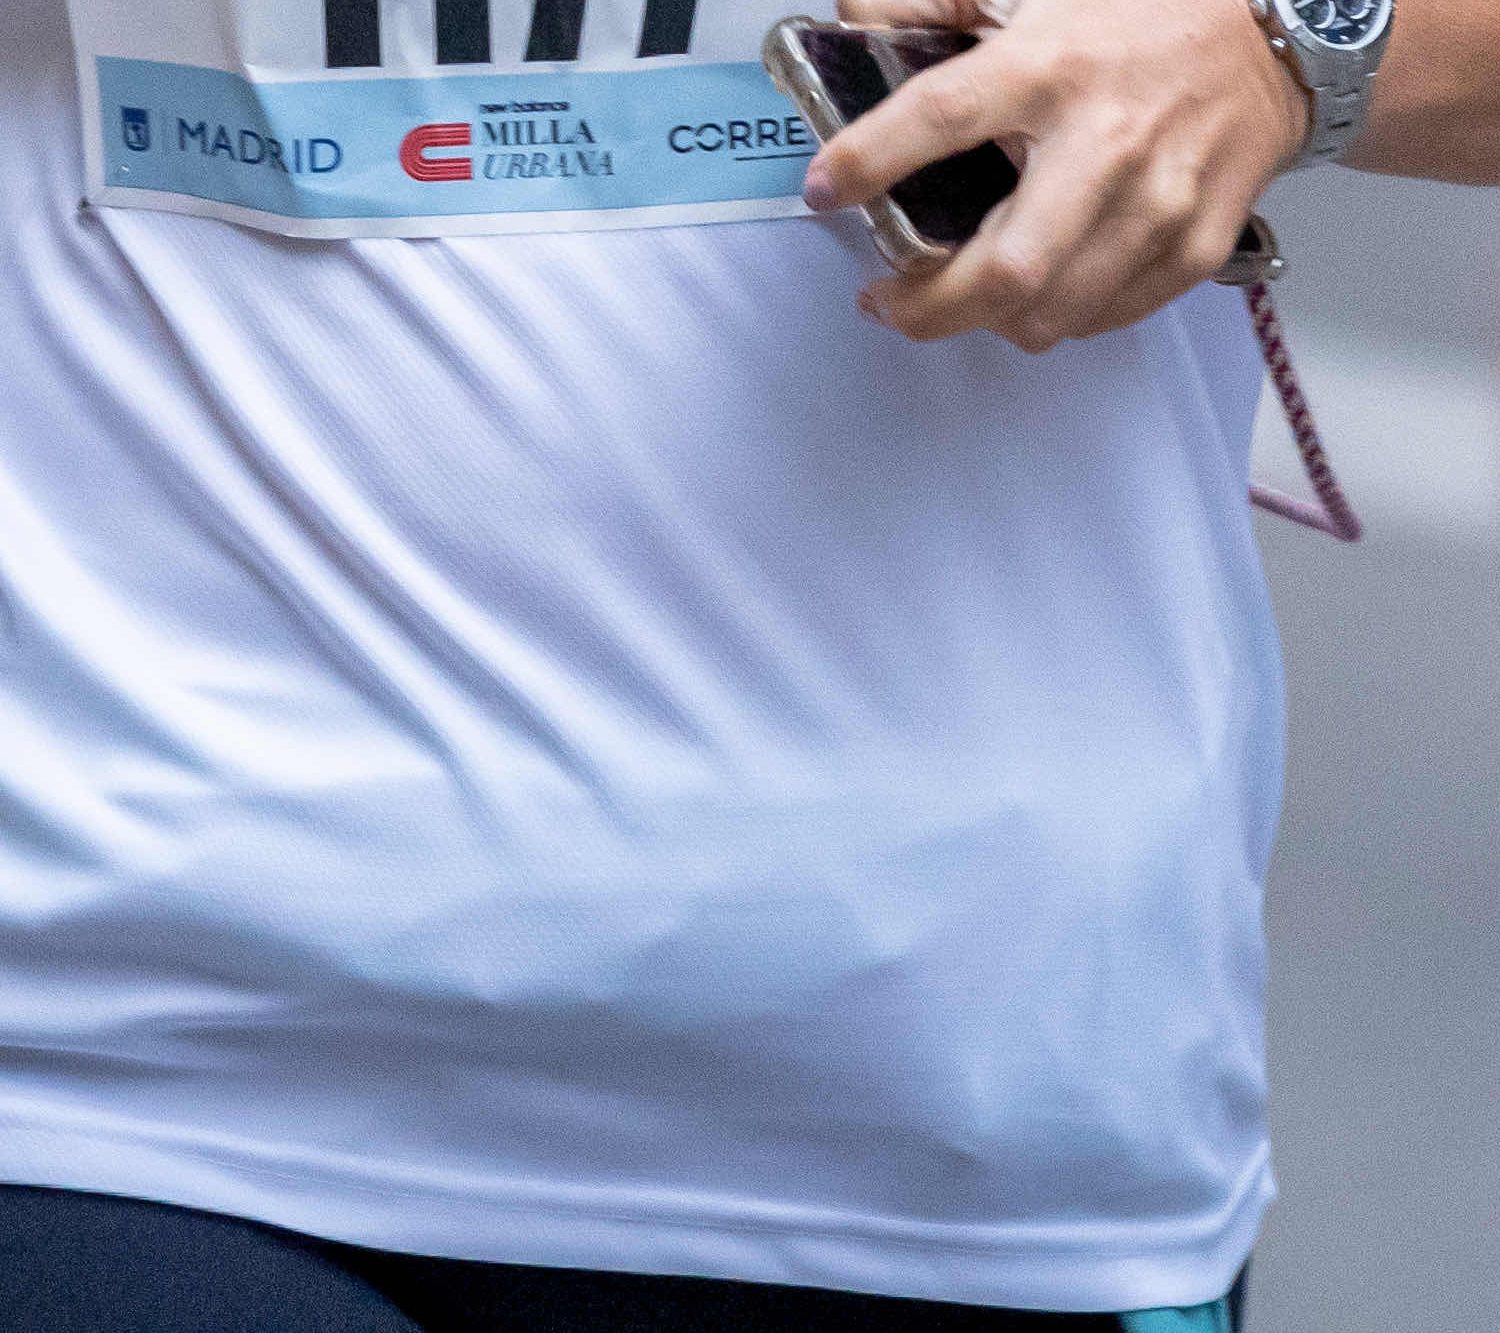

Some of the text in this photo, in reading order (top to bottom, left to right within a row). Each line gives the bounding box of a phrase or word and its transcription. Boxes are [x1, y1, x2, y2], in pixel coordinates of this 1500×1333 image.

[176, 117, 343, 174] MADRID
[482, 119, 596, 146] MILLA
[669, 116, 808, 153] CORRE
[483, 150, 615, 180] URBANA
